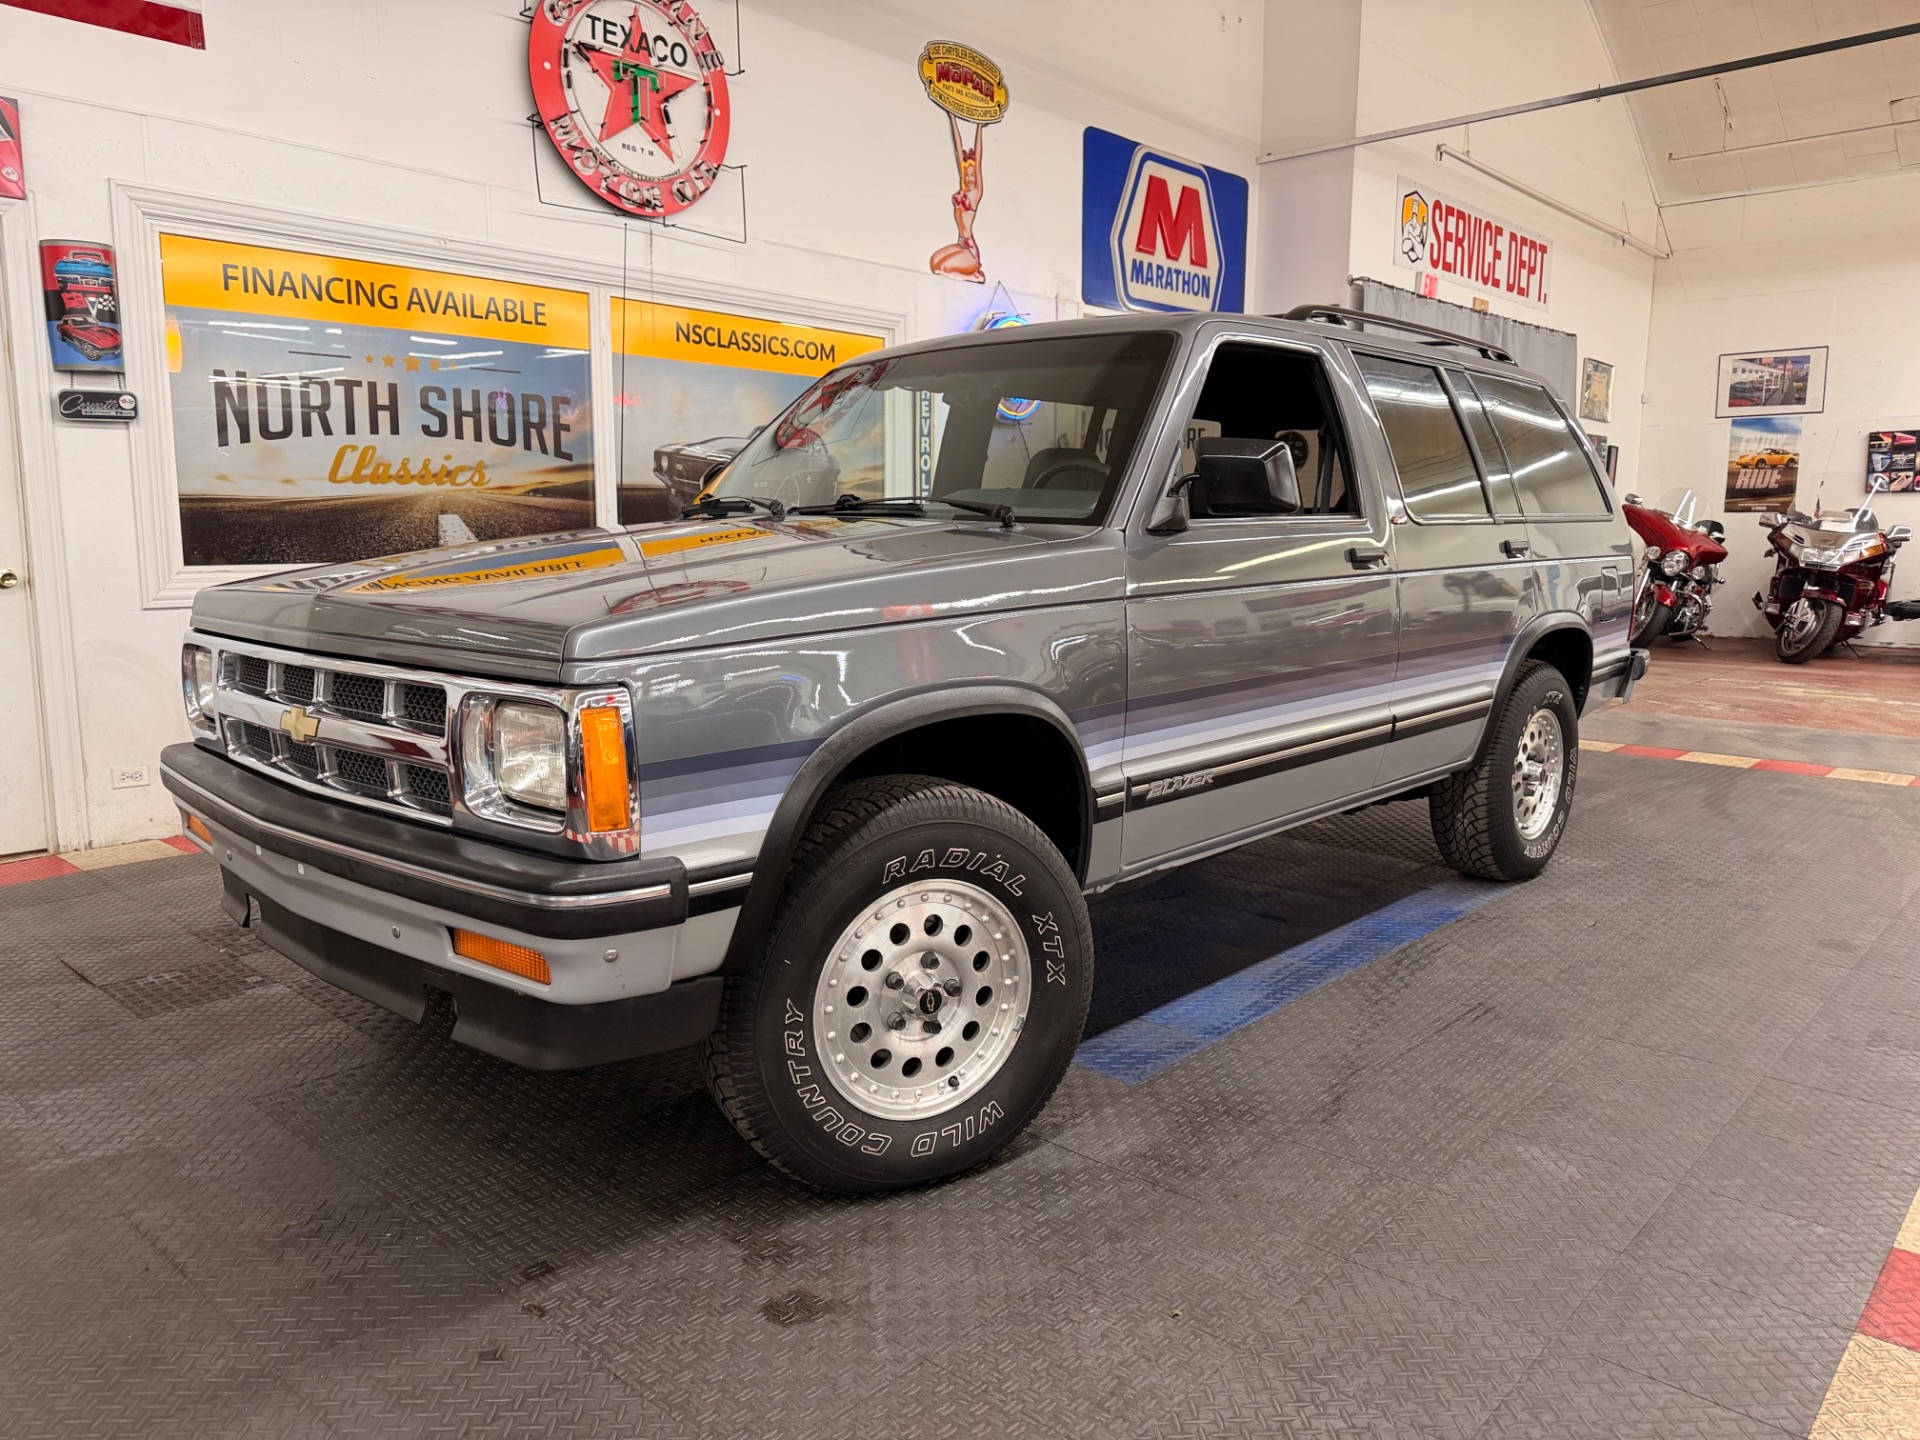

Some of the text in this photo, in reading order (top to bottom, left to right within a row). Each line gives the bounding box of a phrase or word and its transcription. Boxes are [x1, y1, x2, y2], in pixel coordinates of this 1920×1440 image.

[585, 13, 688, 67] TEXACO
[941, 45, 968, 60] CHRYSLER
[935, 61, 995, 103] MOPAR
[548, 112, 722, 213] MOTOR OIL
[1429, 199, 1548, 304] SERVICE DEPT.
[221, 263, 548, 327] FINANCING AVAILABLE
[1130, 258, 1211, 299] MARATHON
[675, 321, 836, 363] NSCLASSICS.COM
[60, 394, 121, 414] Corvette
[212, 367, 575, 462] NORTH SHORE
[327, 444, 493, 487] Classics
[1735, 468, 1783, 489] RIDE
[1145, 768, 1214, 800] BLAZER
[1565, 747, 1578, 805] WILD
[1524, 810, 1566, 859] COUNTRY
[882, 847, 1066, 986] RADIAL XTX
[783, 998, 893, 1156] COUNTRY
[910, 1101, 1004, 1158] WILD
